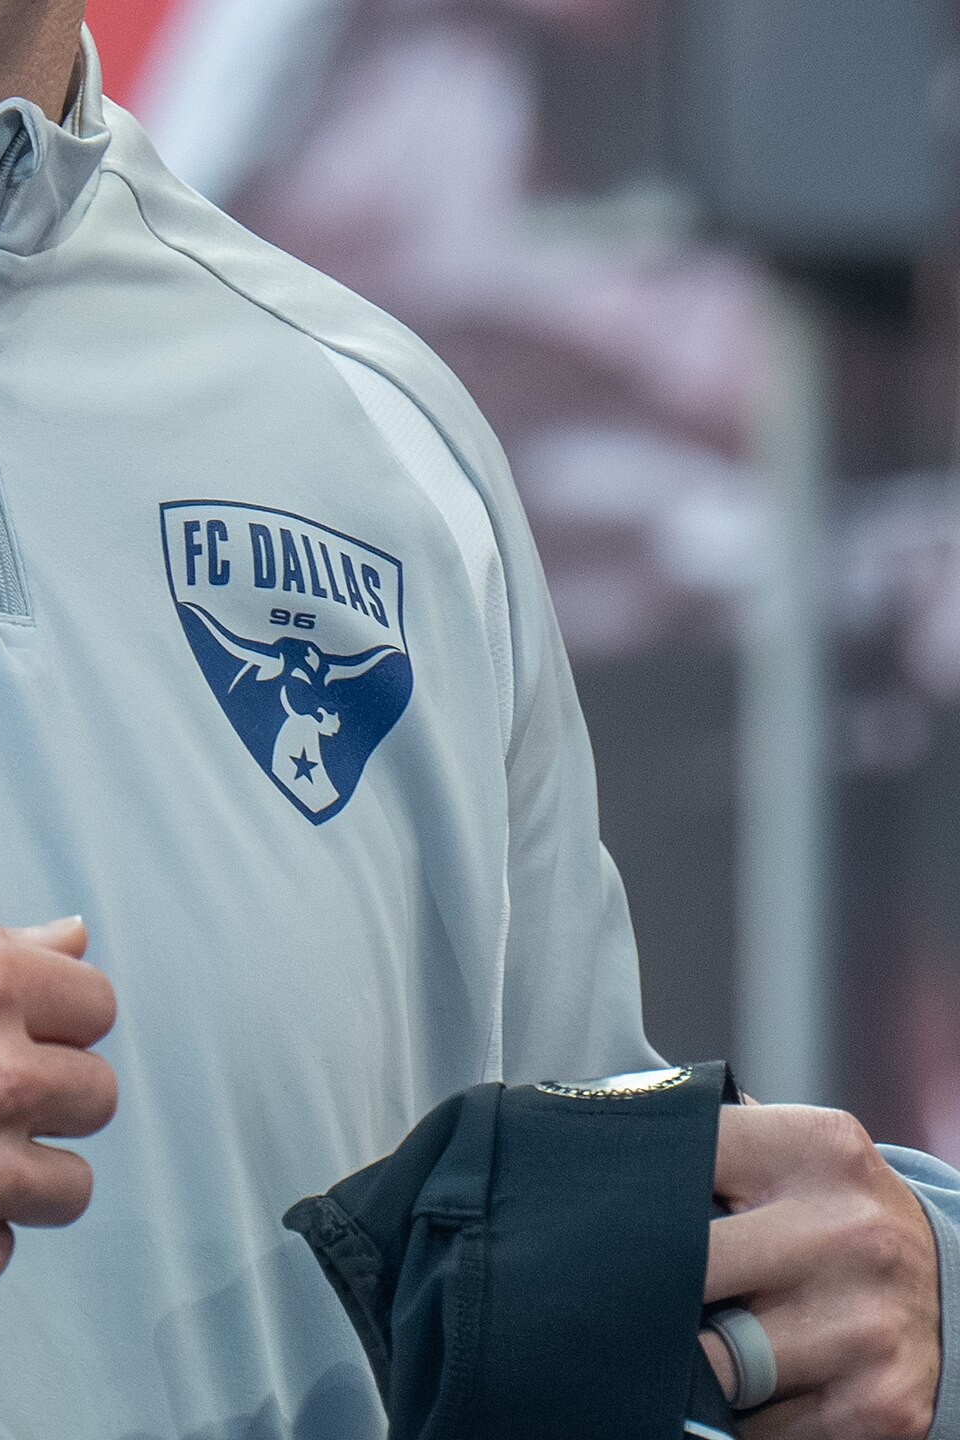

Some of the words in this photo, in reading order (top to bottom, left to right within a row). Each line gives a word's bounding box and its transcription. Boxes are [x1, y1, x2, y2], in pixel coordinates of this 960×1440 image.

[183, 519, 231, 586] FC
[248, 522, 390, 629] DALLAS
[269, 607, 317, 630] 96
